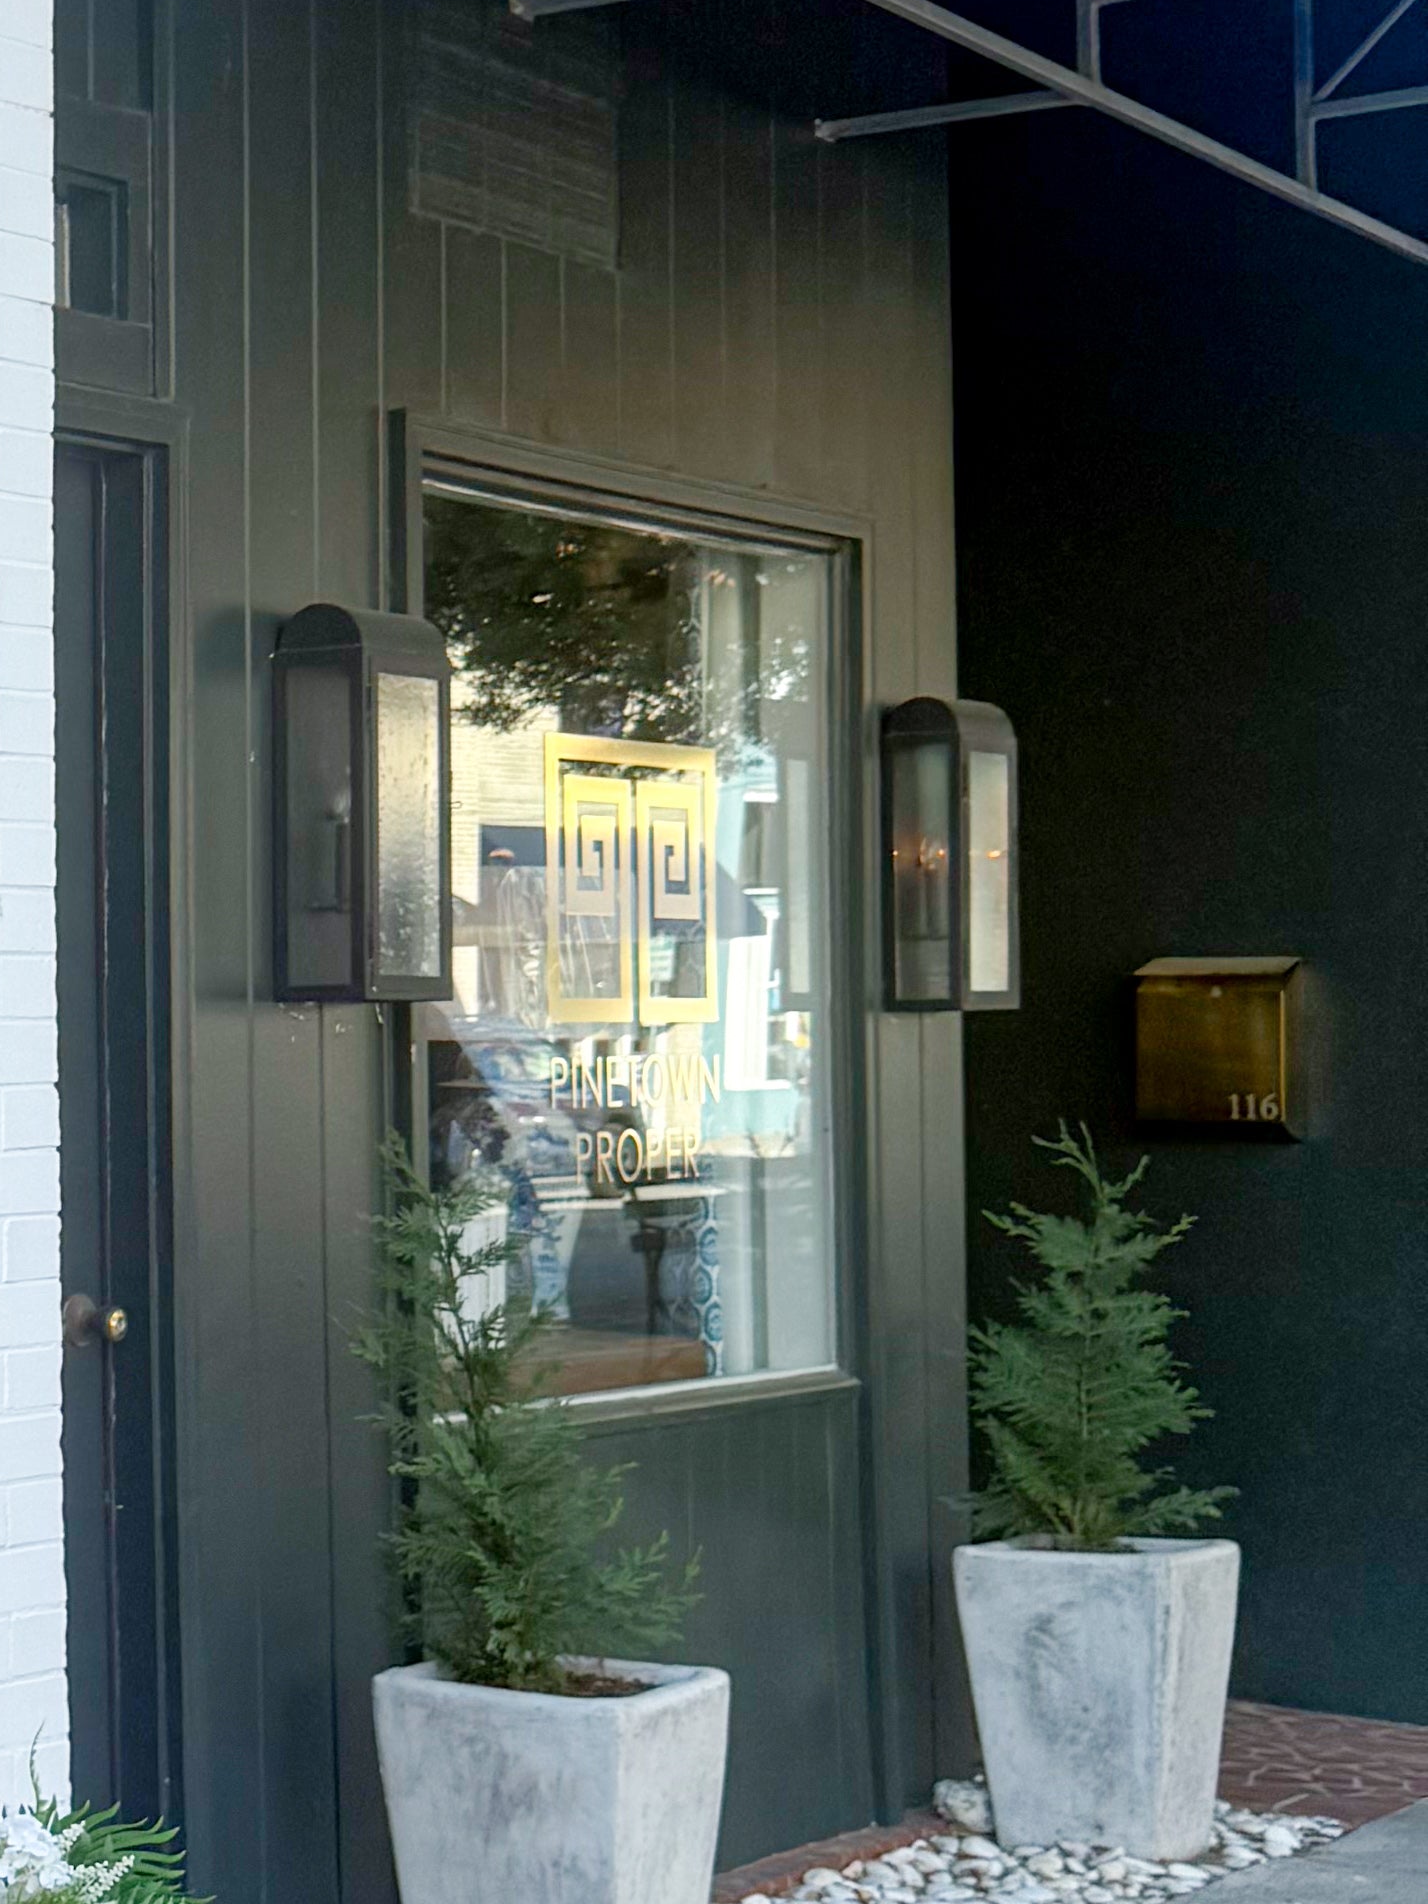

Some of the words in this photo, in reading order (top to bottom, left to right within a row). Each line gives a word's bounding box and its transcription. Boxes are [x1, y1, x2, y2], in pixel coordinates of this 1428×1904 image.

[551, 1053, 721, 1109] PINETOWN
[1229, 1093, 1279, 1120] 116
[576, 1127, 700, 1184] PROPER
